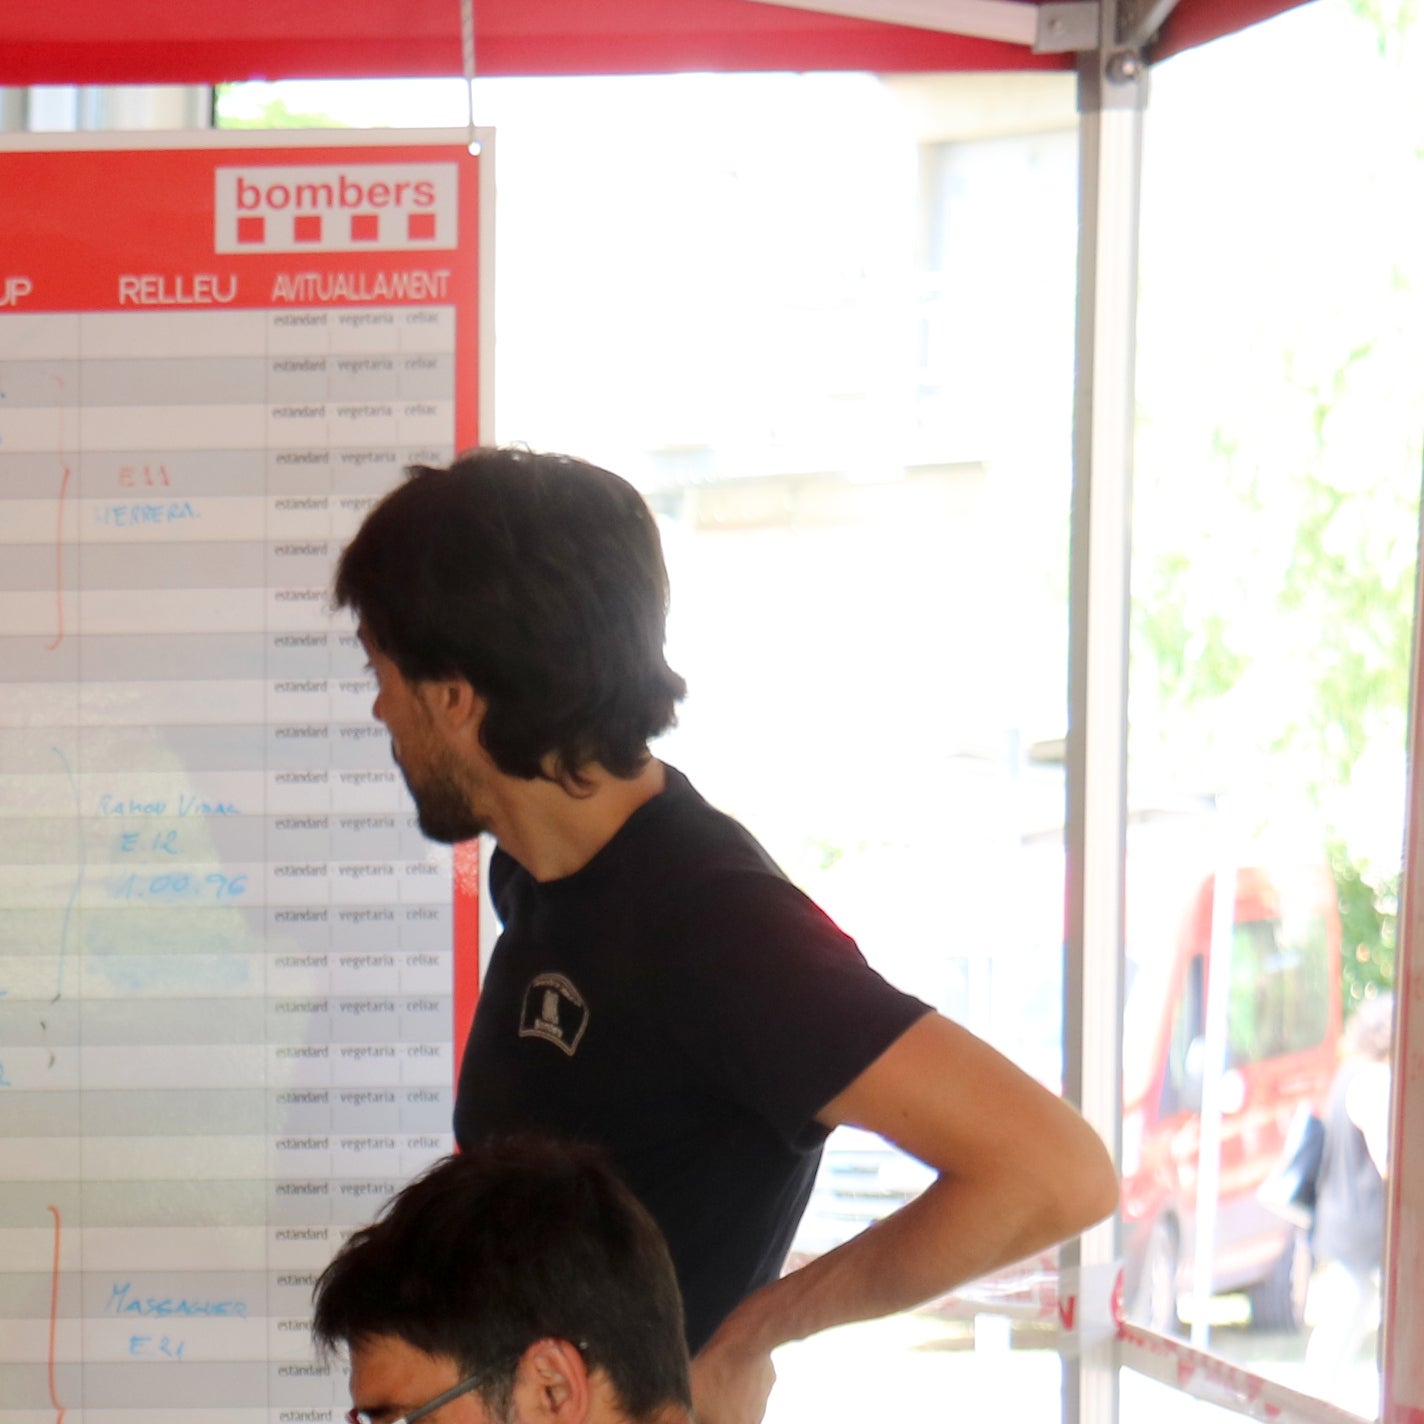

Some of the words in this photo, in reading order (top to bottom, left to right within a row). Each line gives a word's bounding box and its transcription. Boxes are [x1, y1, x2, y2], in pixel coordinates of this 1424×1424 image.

[236, 175, 436, 211] bombers
[119, 274, 237, 305] RELLEU
[271, 269, 450, 302] AVITUALLAMENT
